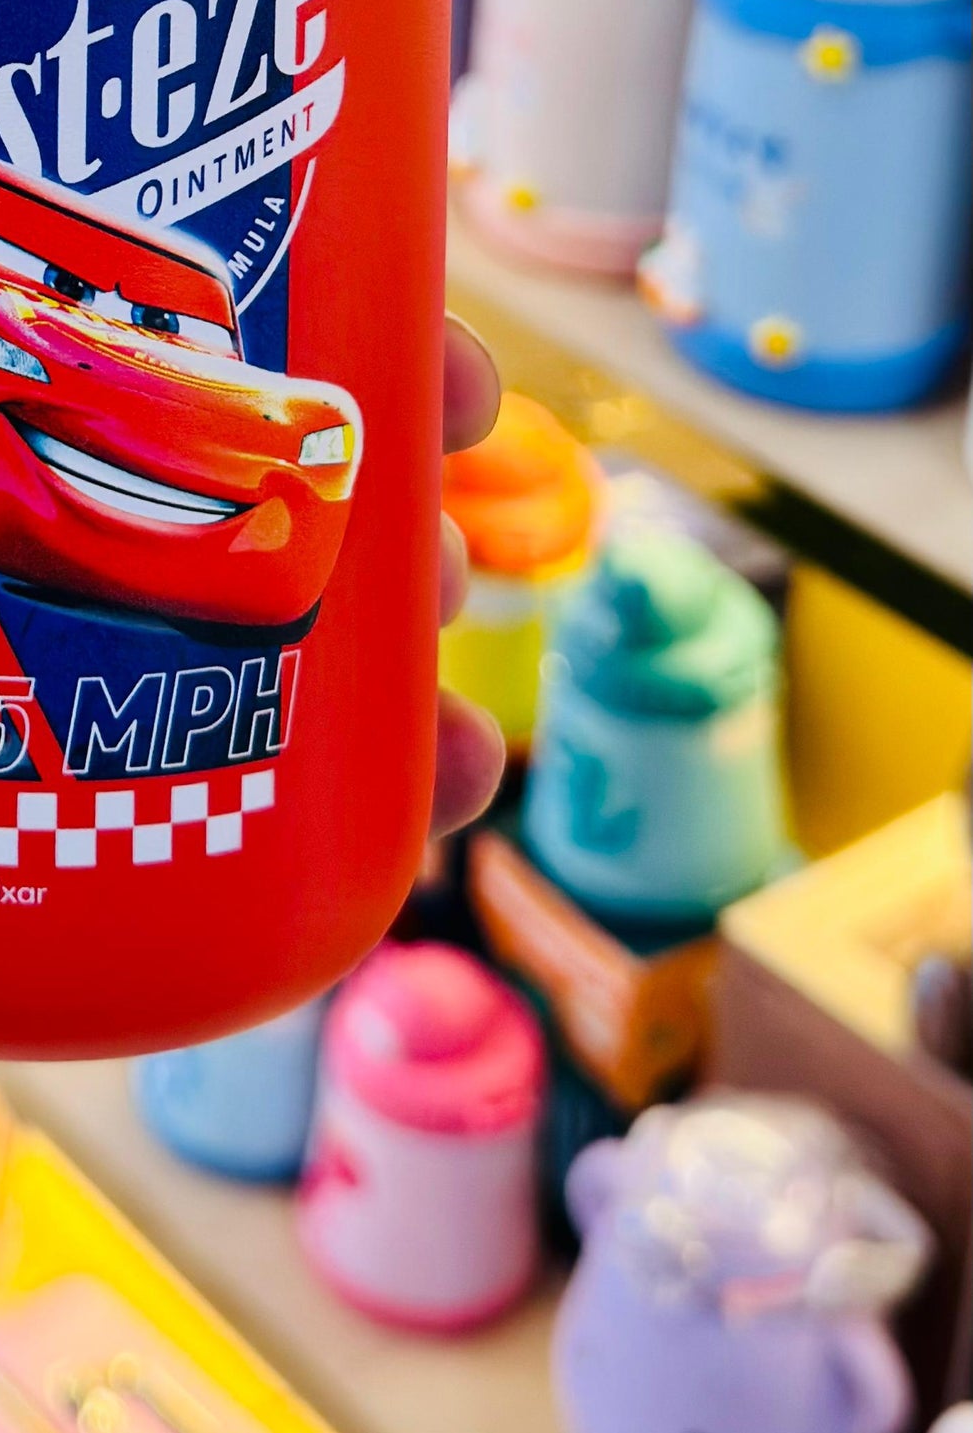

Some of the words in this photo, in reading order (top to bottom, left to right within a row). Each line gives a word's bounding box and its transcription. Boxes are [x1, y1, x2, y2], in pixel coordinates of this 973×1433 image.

[136, 101, 315, 220] OINTMENT
[227, 194, 285, 280] MULA
[62, 649, 302, 775] MPH
